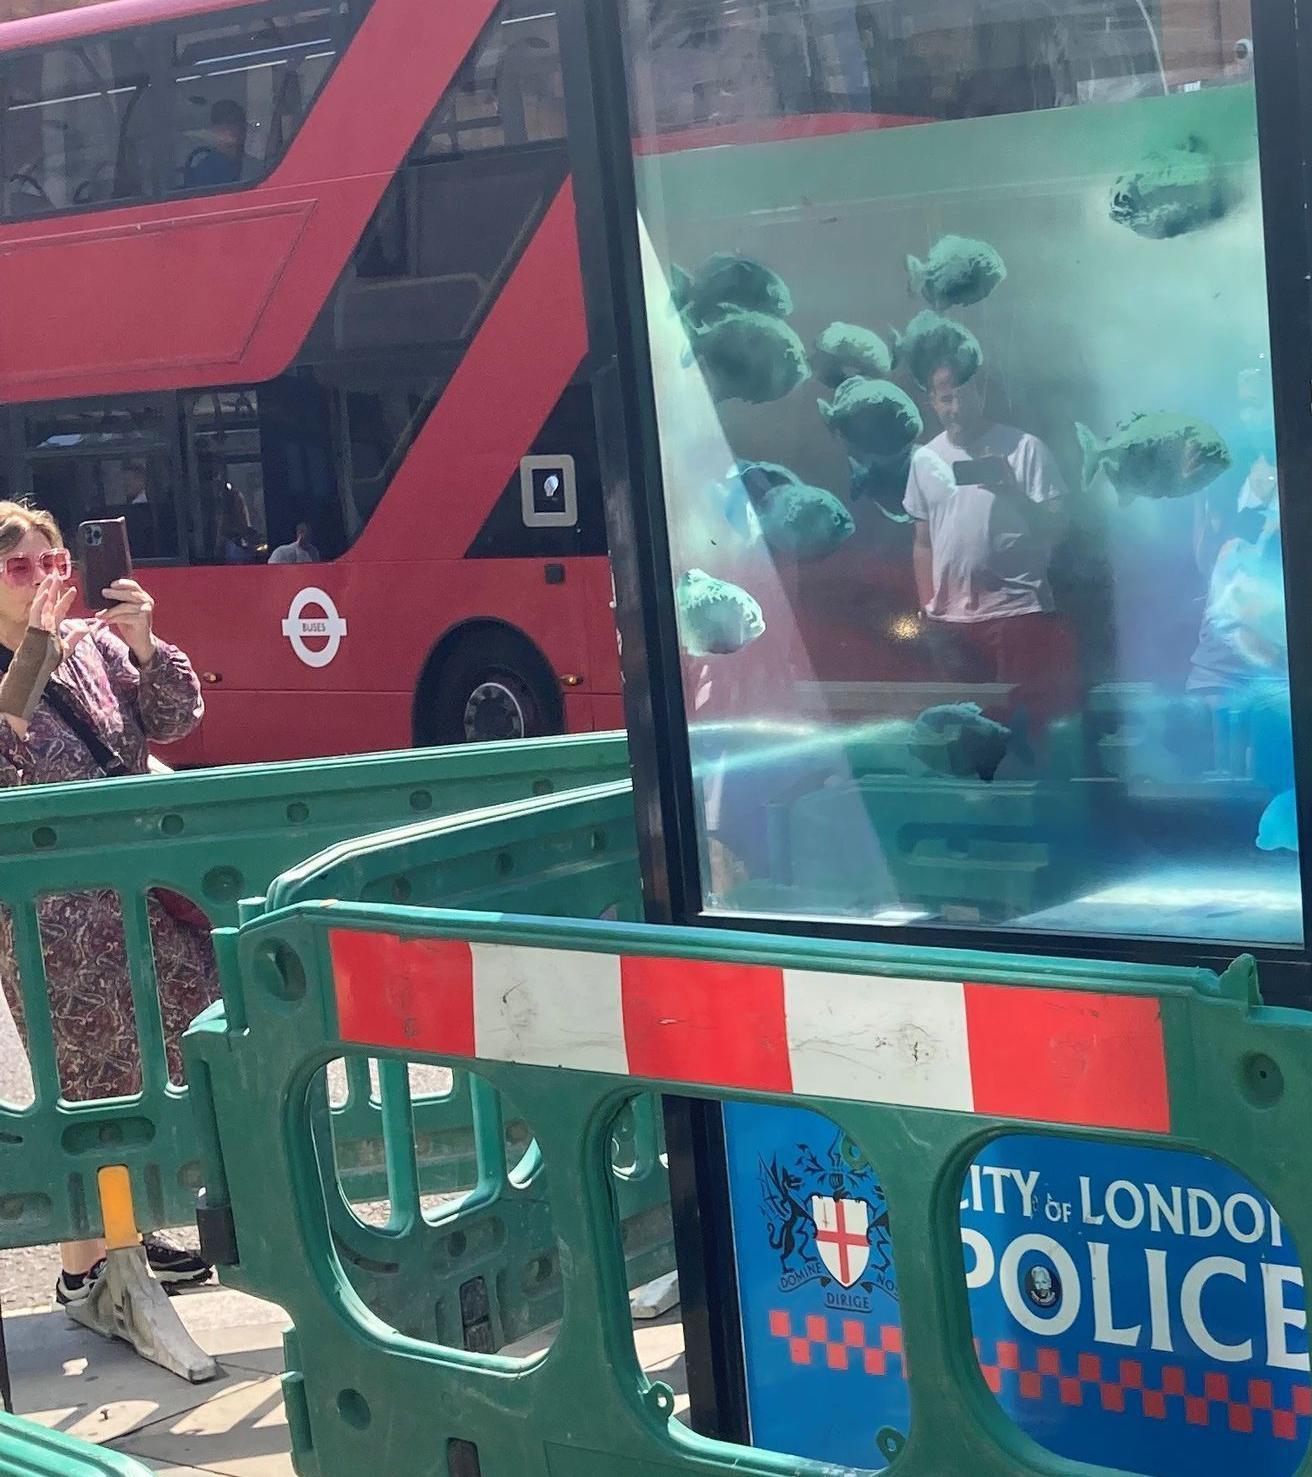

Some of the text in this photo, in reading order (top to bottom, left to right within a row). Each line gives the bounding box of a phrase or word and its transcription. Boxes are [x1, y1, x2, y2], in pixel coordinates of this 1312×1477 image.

[302, 622, 326, 632] BUSES
[960, 1165, 1040, 1217] ITY
[1045, 1201, 1072, 1223] OF
[780, 1262, 822, 1288] DOMINE
[876, 1273, 898, 1296] NO
[826, 1292, 870, 1309] DIRIGE
